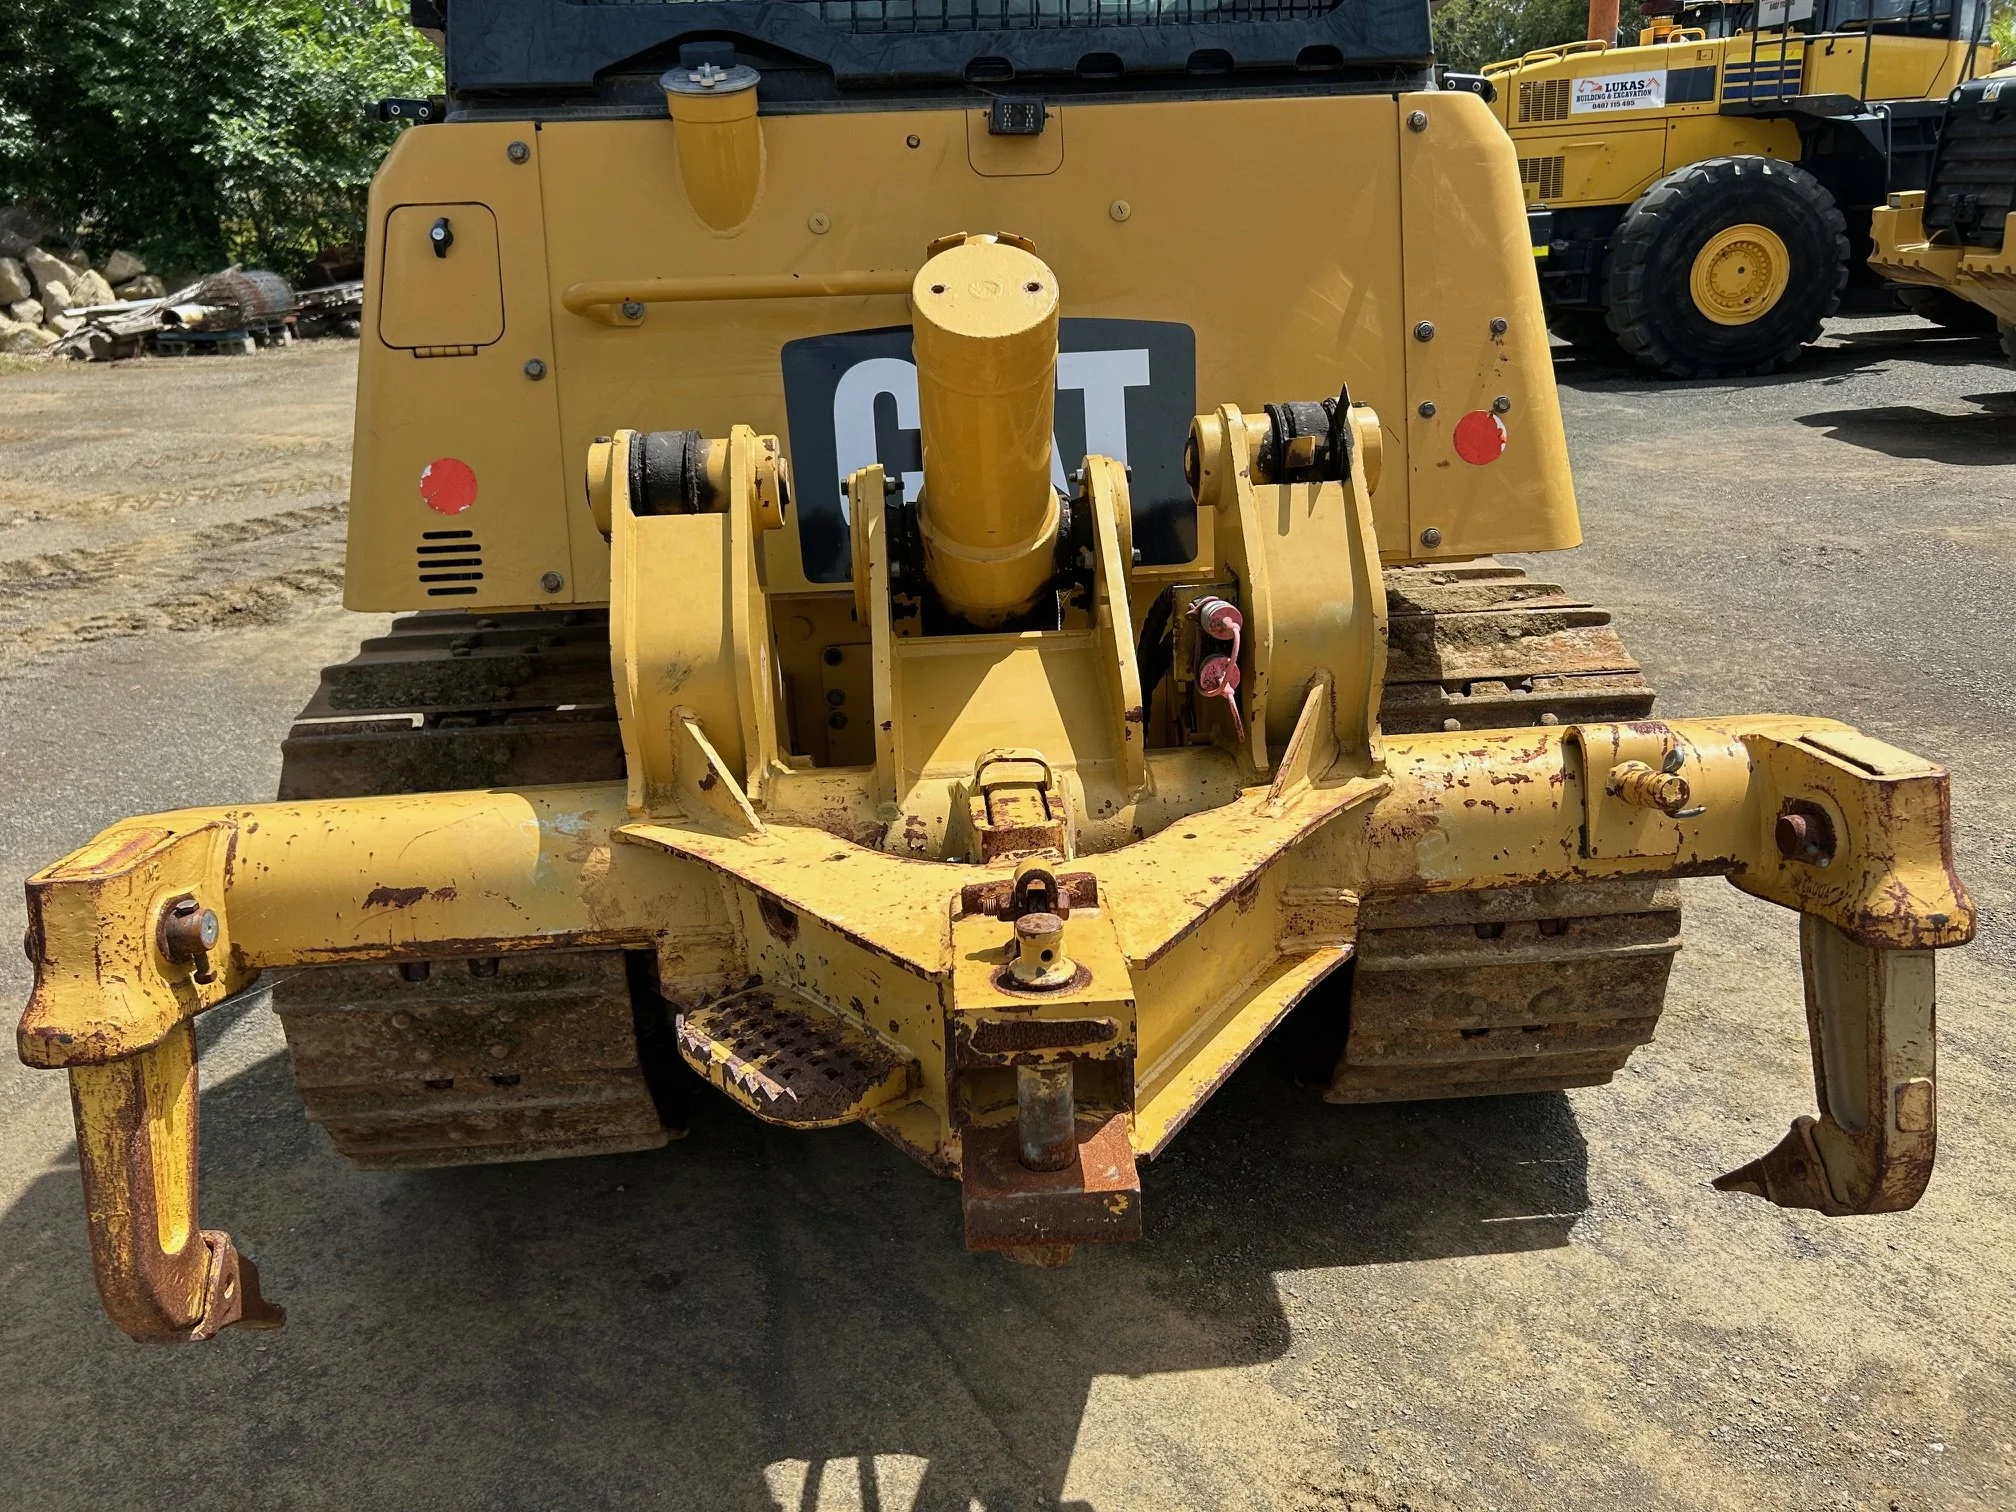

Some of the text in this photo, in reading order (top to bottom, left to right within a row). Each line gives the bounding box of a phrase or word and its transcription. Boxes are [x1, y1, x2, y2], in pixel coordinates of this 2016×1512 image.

[1605, 80, 1645, 93] LUKAS
[1576, 93, 1606, 102] BUILDING
[1613, 89, 1652, 99] EXCAVATION
[834, 348, 1151, 527] CT
